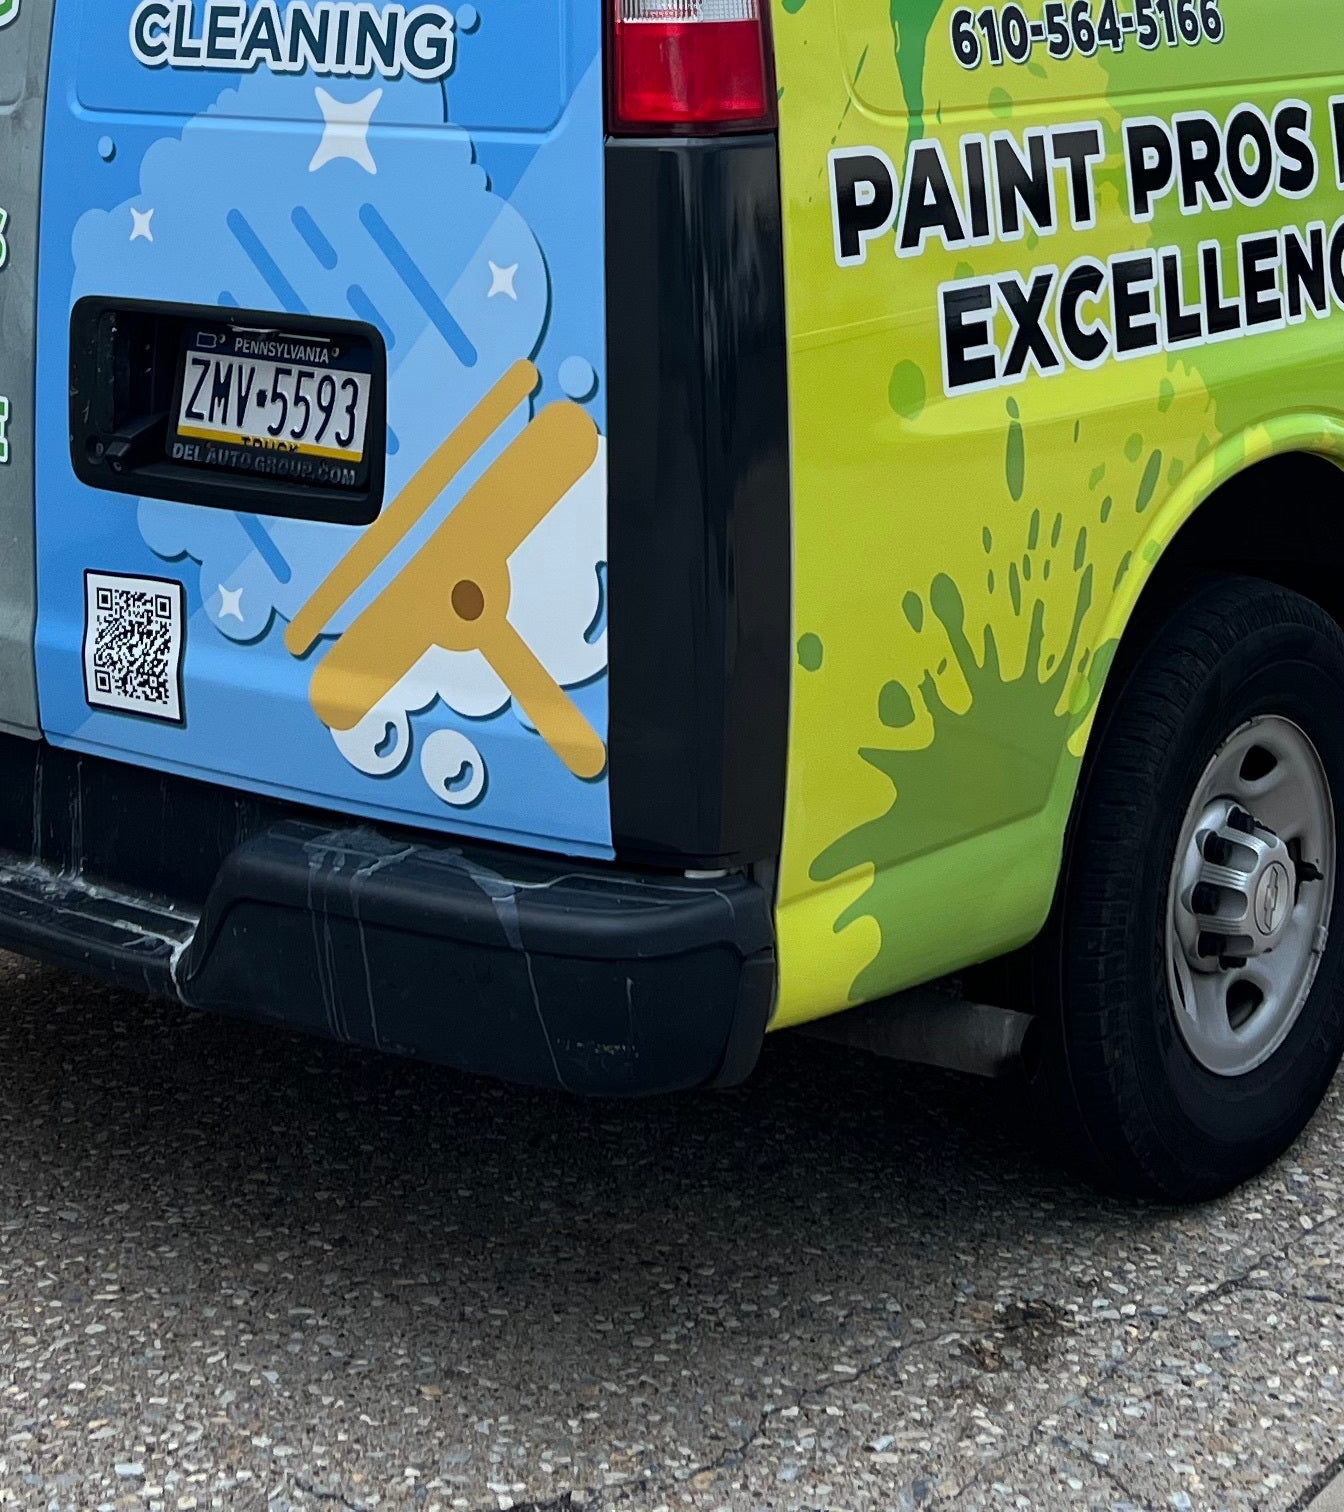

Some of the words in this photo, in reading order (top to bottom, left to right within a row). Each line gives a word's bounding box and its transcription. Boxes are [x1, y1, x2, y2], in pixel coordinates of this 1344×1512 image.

[131, 0, 453, 76] CLEANING
[830, 125, 1102, 262] PAINT
[1123, 103, 1317, 219] PROS
[234, 336, 331, 364] PENNSYLVANIA
